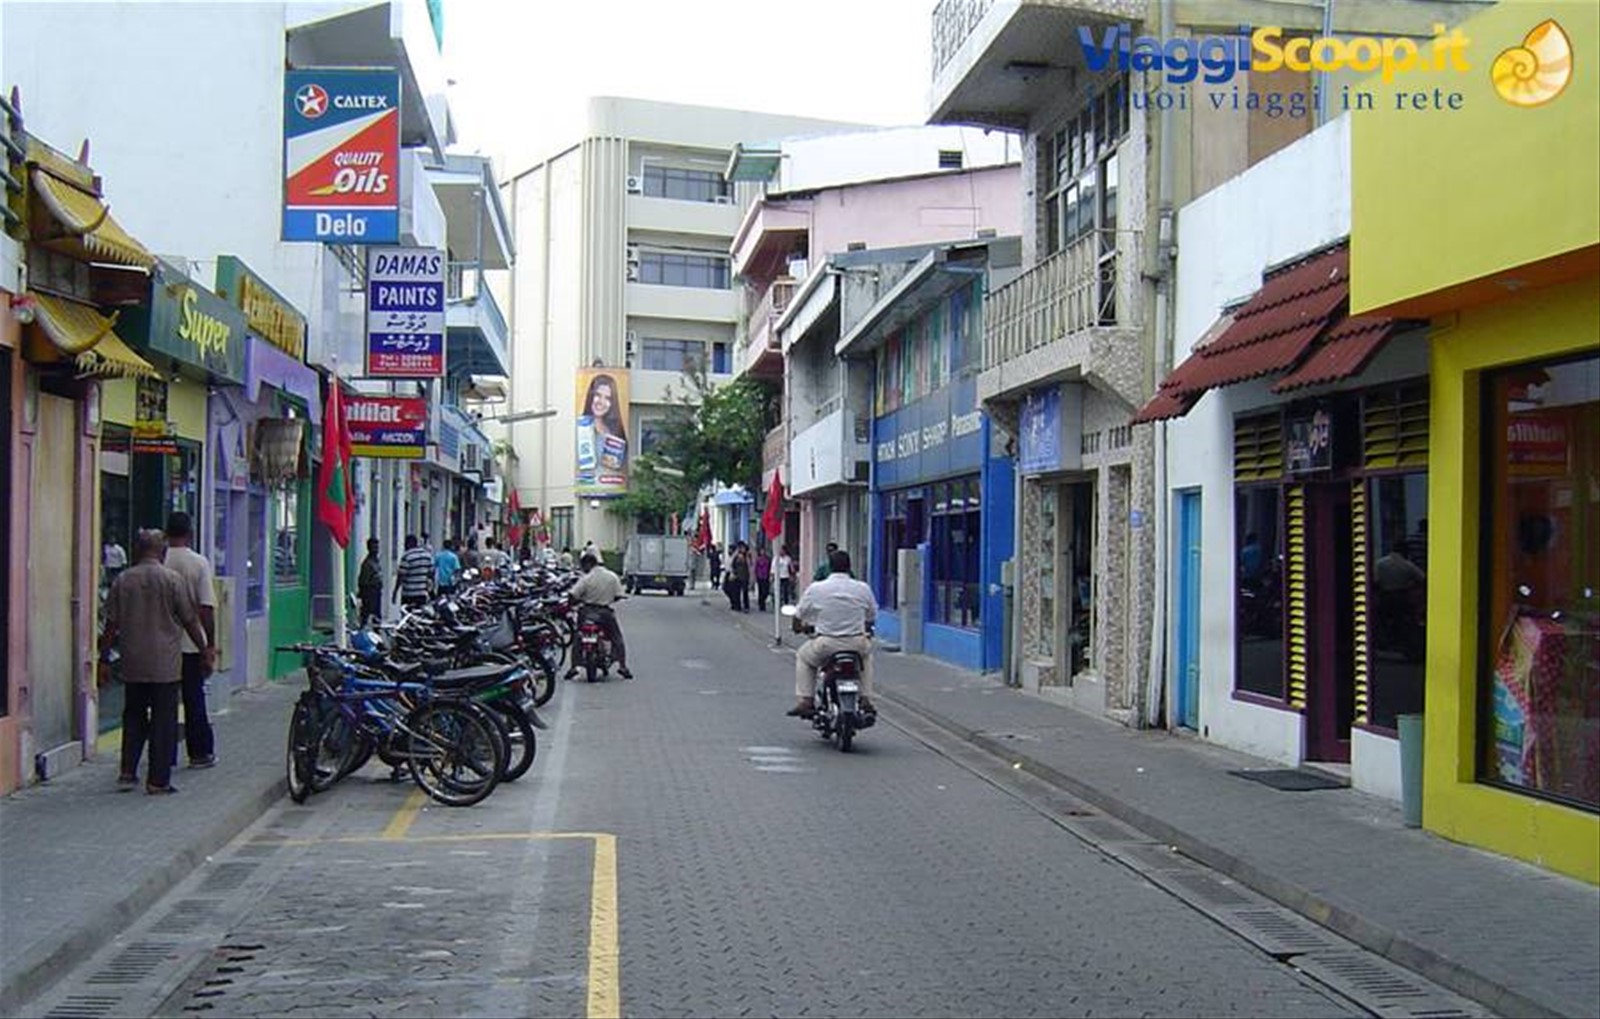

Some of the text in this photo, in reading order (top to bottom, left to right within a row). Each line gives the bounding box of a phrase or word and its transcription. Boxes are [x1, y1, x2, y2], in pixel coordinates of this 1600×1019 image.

[334, 95, 388, 109] CALTEX
[334, 152, 384, 167] QUALITY
[333, 167, 390, 194] Oils
[315, 212, 366, 236] Delo
[375, 254, 441, 276] DAMAS
[379, 287, 437, 306] PAINTS
[179, 288, 230, 361] Super
[897, 429, 920, 459] SONY
[922, 420, 948, 450] SHOP
